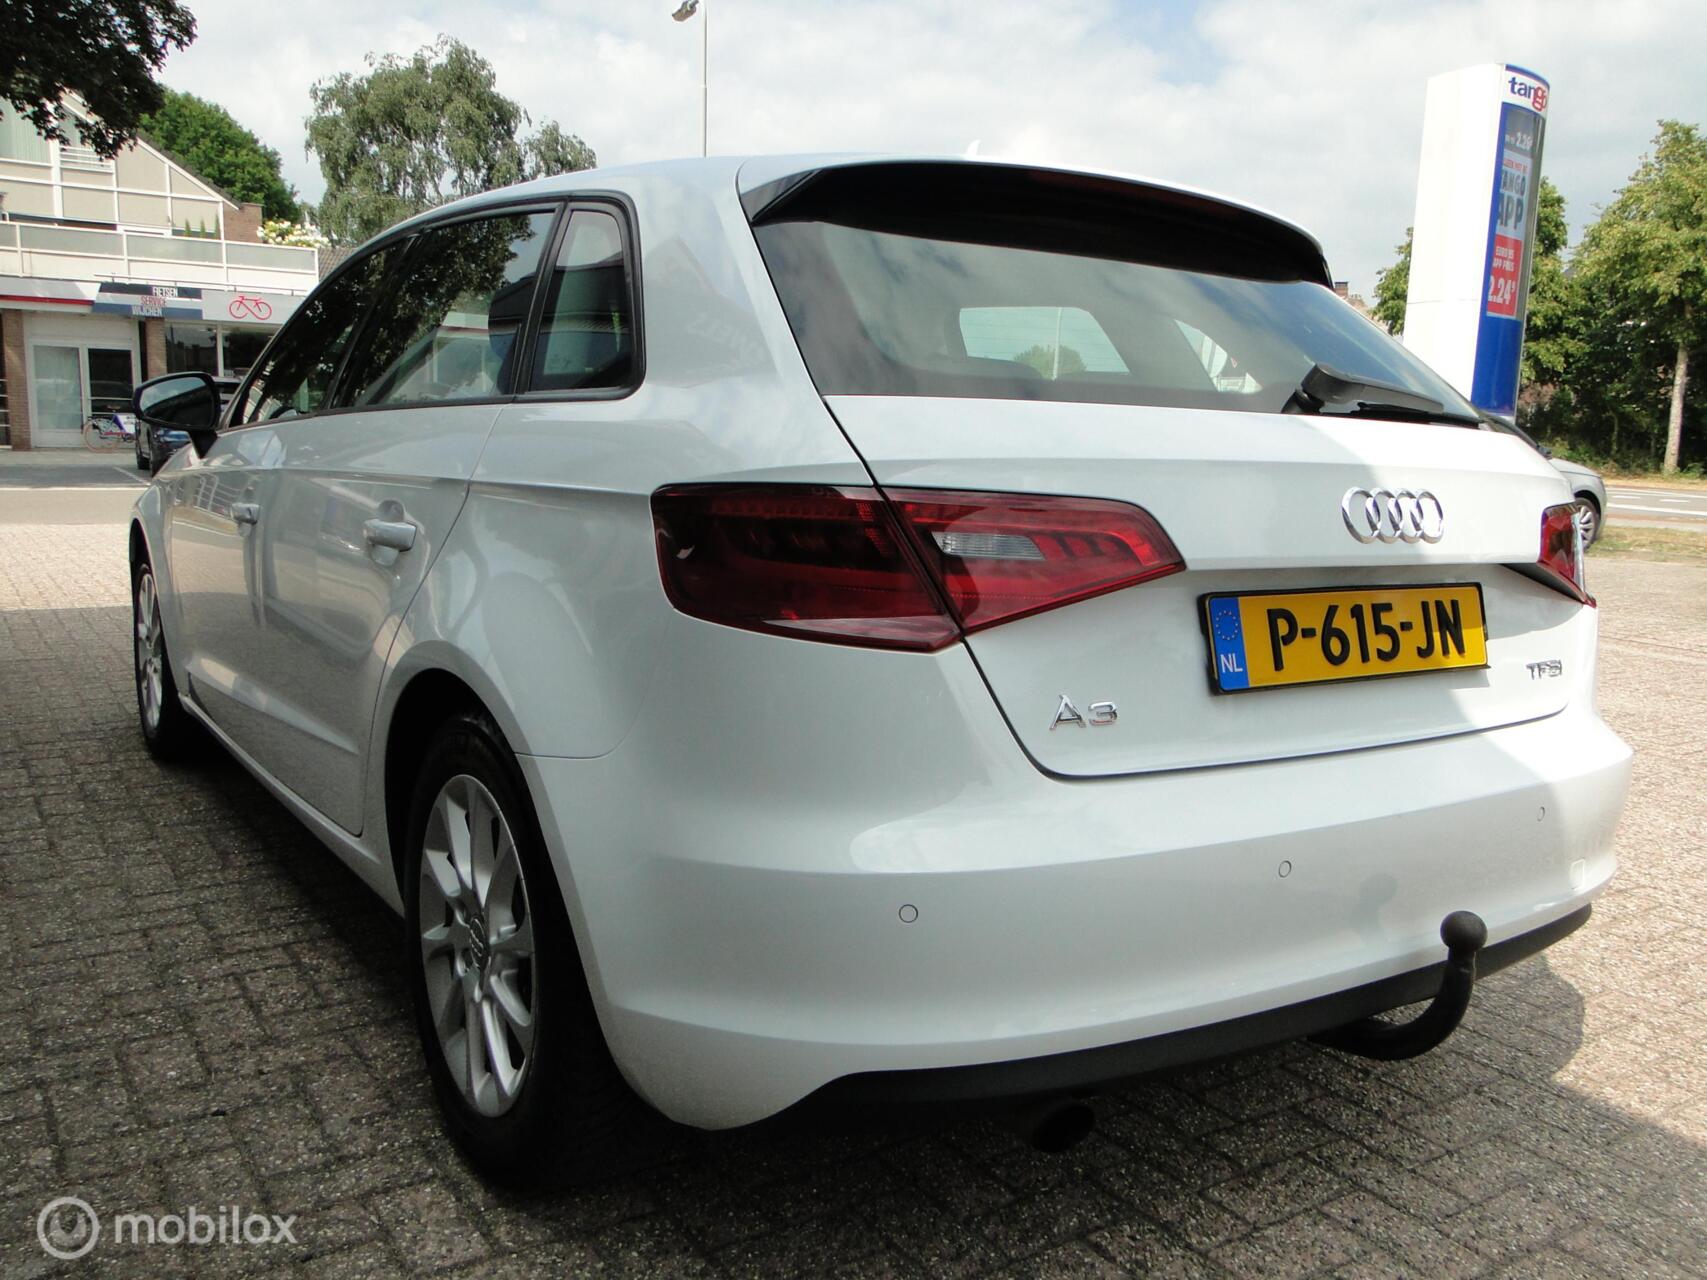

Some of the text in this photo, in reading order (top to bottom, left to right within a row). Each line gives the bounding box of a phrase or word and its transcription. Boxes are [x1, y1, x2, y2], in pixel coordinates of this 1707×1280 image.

[1508, 76, 1547, 112] tango
[152, 286, 178, 298] FIETSEN
[1265, 598, 1467, 672] P-615-JN
[1220, 653, 1244, 674] NL
[1526, 659, 1562, 680] TFSI
[1049, 693, 1118, 730] A3
